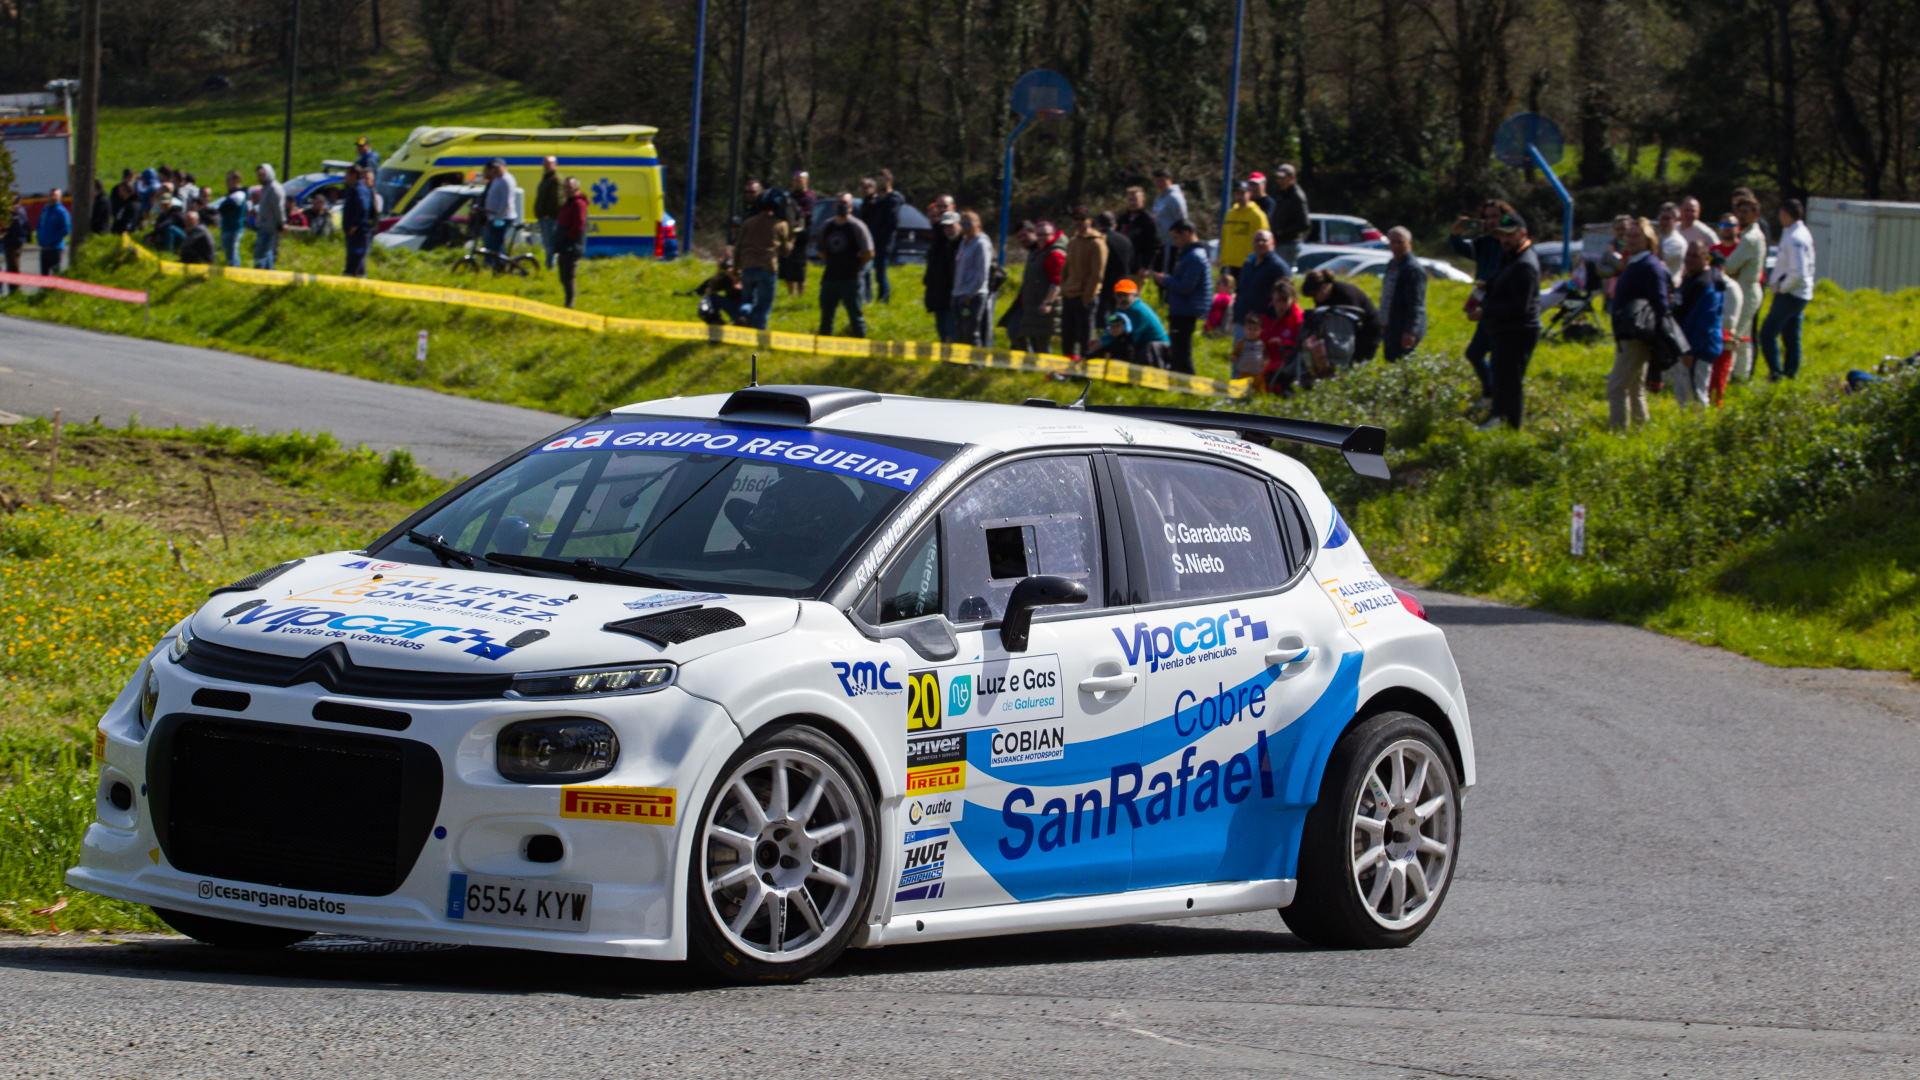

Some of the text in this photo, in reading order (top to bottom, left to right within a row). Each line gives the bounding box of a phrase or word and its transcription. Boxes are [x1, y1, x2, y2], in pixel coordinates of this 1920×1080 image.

[612, 431, 739, 450] GRUPO
[738, 437, 920, 486] REGUEIRA
[1163, 522, 1252, 544] C.Garabatos
[1171, 553, 1225, 575] S.Nieto
[236, 604, 466, 634] Vipcar
[281, 625, 324, 637] venta
[324, 628, 348, 640] de
[1112, 613, 1230, 674] Vipcar
[1160, 658, 1184, 671] venta
[1185, 655, 1197, 666] de
[976, 668, 1056, 696] Luz e Gas
[907, 673, 940, 730] 20
[1002, 695, 1055, 712] de Galuresa
[1174, 682, 1266, 737] Cobre
[991, 726, 1065, 755] COBIAN
[991, 749, 1063, 765] INSURANCE MOTORSPORT
[907, 767, 960, 791] PIRELLI
[564, 790, 674, 818] PIRELLI
[904, 840, 949, 870] HVC
[214, 884, 347, 915] cesargarabatos
[466, 884, 528, 916] 6554
[535, 889, 587, 922] KYW
